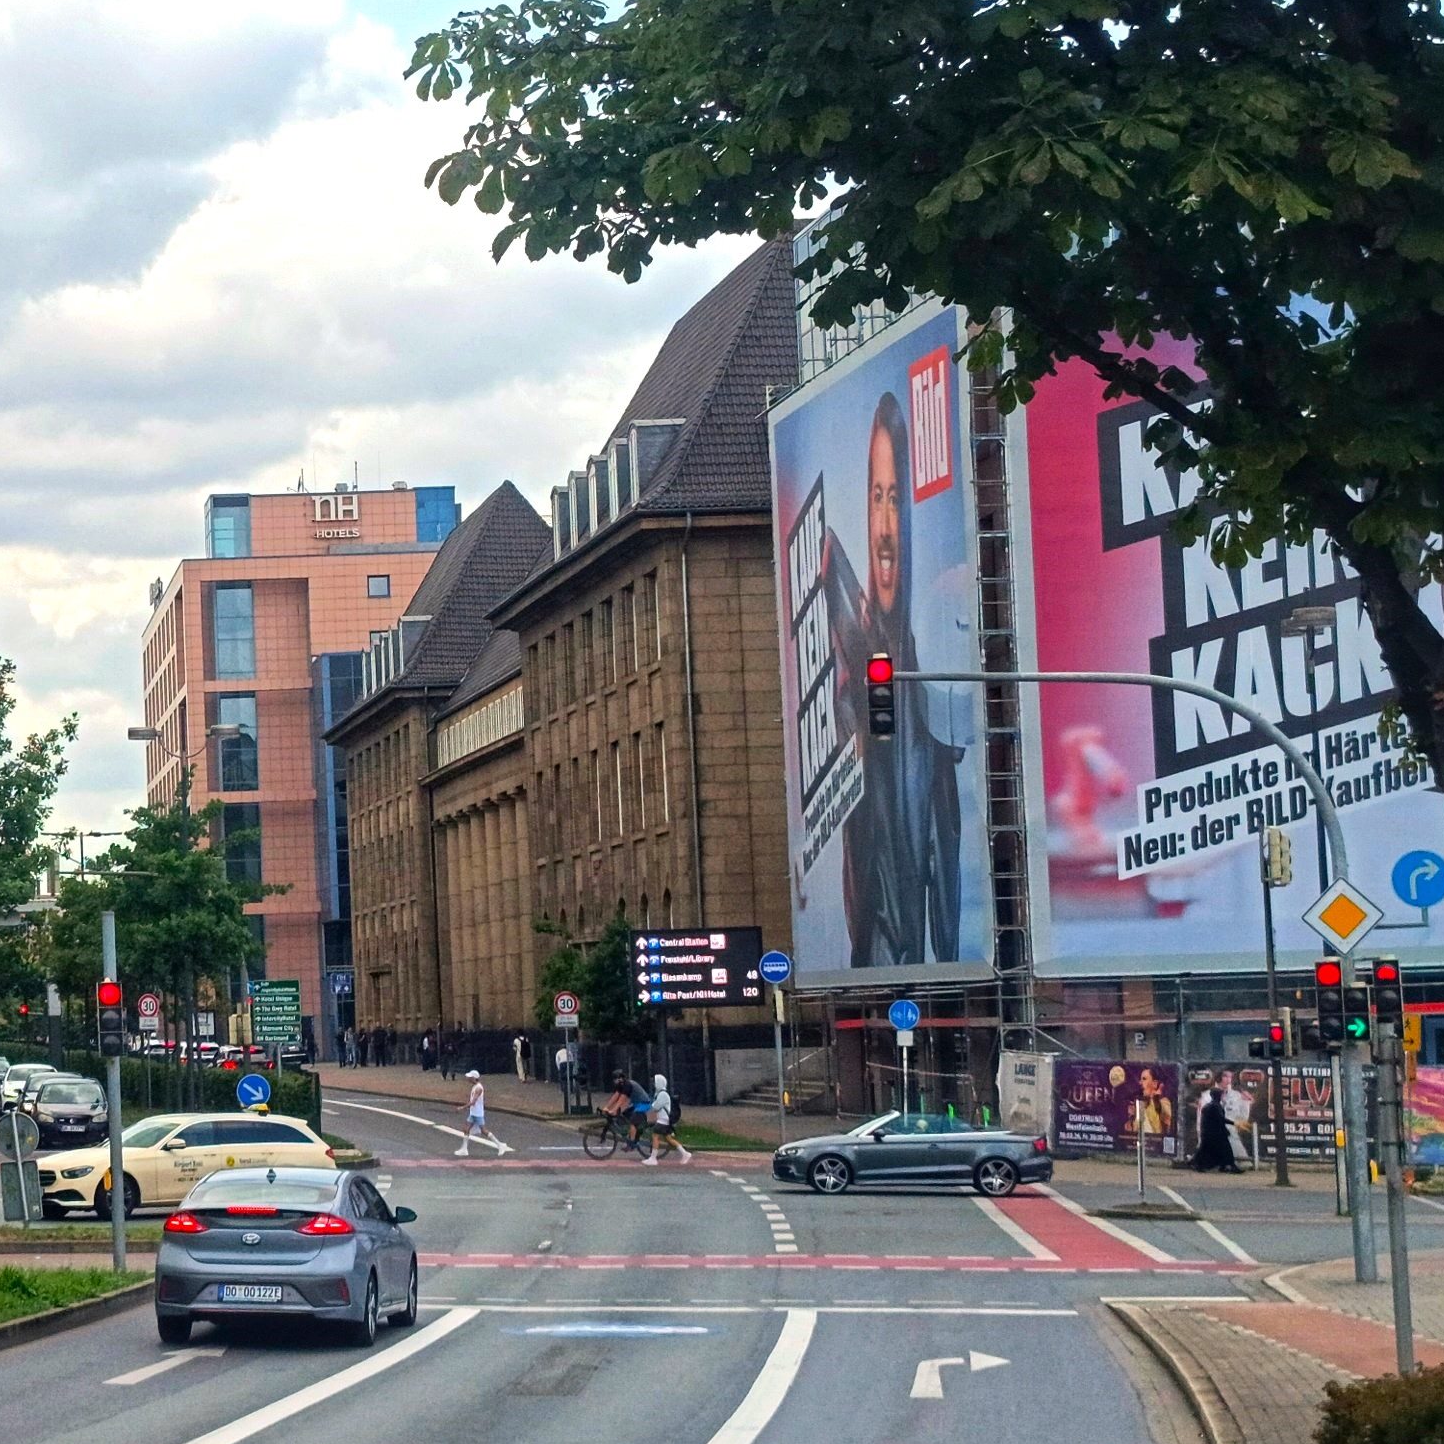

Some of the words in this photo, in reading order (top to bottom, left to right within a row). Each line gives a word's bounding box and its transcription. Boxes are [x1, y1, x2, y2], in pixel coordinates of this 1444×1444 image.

[912, 360, 949, 489] Bild
[316, 528, 361, 538] HOTELS
[790, 490, 823, 622] KAUF
[798, 587, 831, 700] KEIN
[800, 665, 838, 796] KACK
[1145, 755, 1279, 824] Produkte
[1124, 831, 1186, 872] Neu:
[1190, 807, 1242, 854] der
[142, 1000, 155, 1012] 30
[559, 998, 574, 1009] 30
[742, 987, 759, 997] 120
